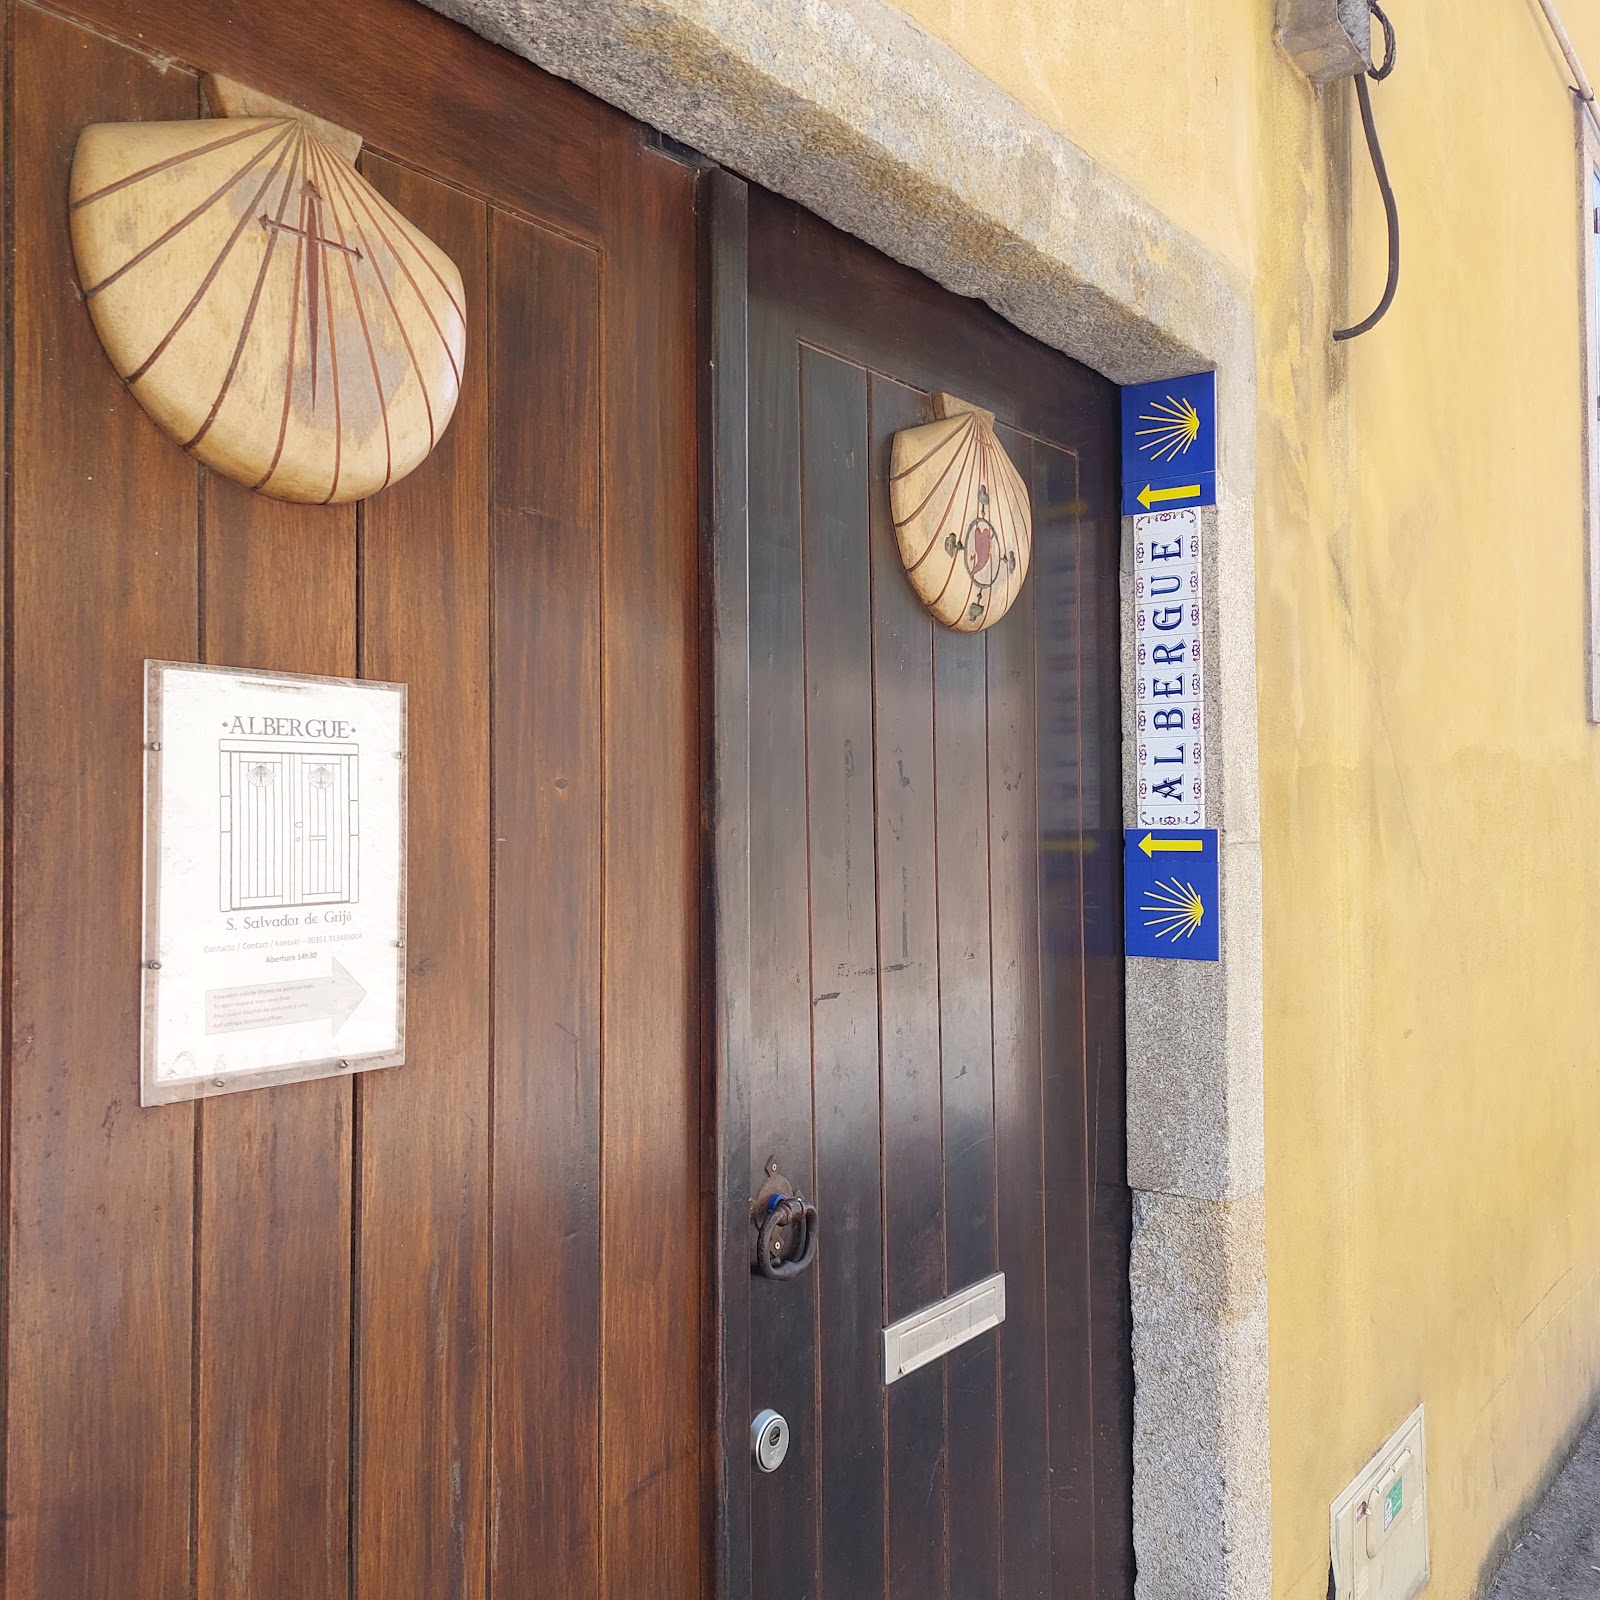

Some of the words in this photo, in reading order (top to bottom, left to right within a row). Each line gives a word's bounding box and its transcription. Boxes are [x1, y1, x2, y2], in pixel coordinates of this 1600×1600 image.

[1151, 535, 1187, 803] ALBERGUE
[228, 715, 350, 739] ALBERGUE
[226, 917, 237, 931] S.
[243, 914, 299, 930] Salvador
[304, 912, 319, 925] de
[324, 910, 352, 926] Grijó
[203, 944, 236, 953] Contacto
[242, 941, 269, 950] Contact
[275, 938, 301, 947] Kontakt
[265, 954, 296, 964] Abertura
[297, 951, 318, 961] 14h30
